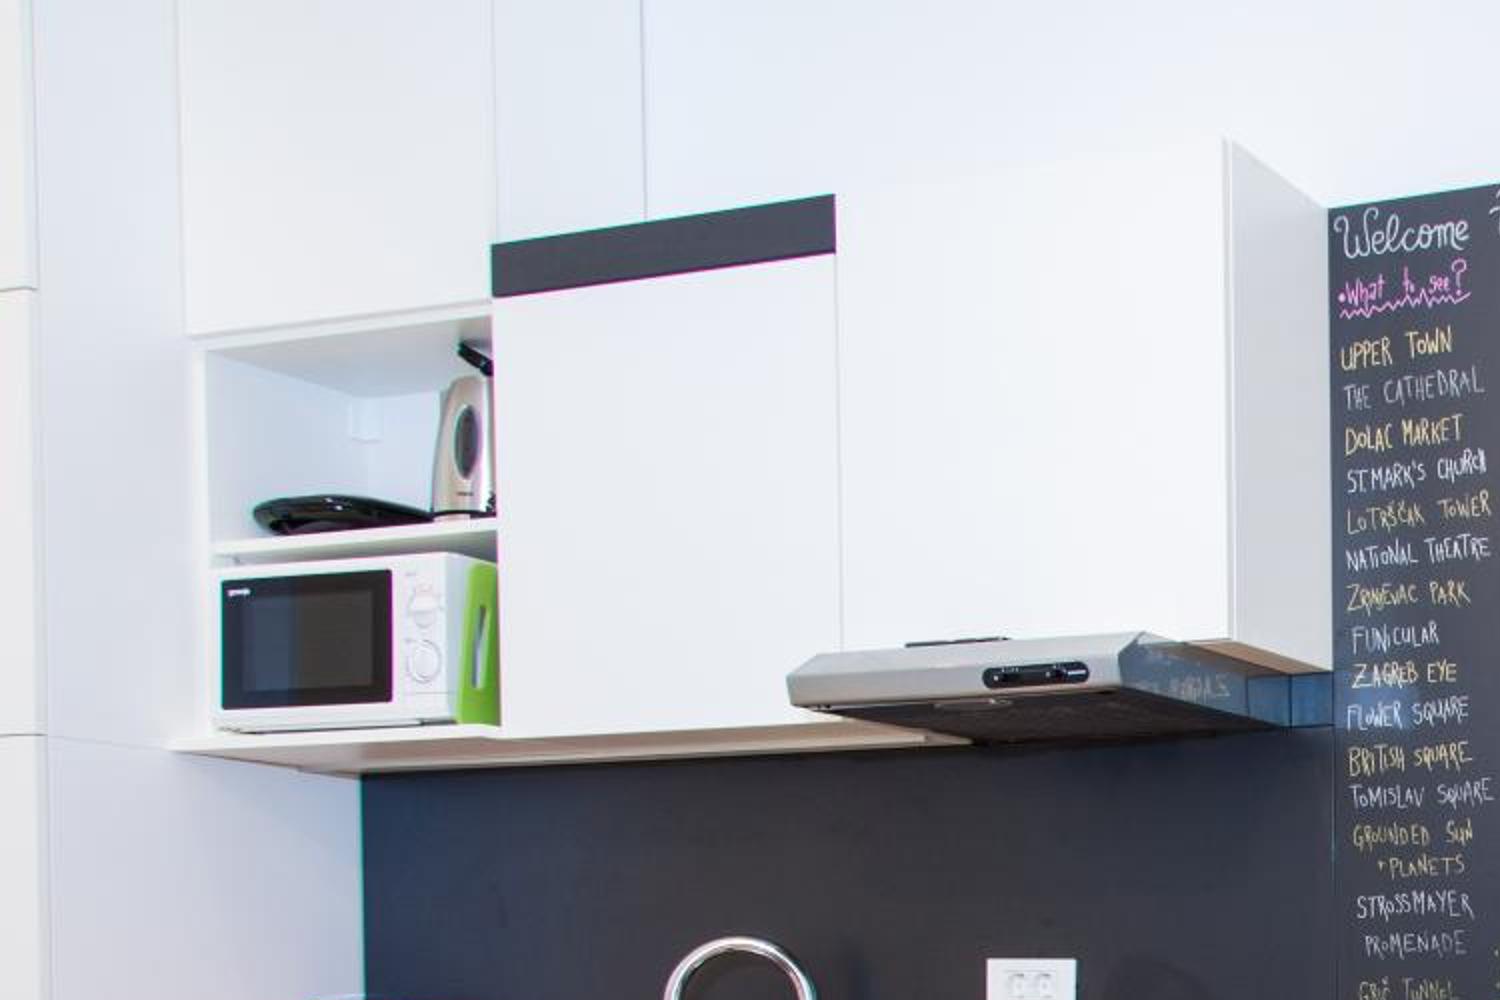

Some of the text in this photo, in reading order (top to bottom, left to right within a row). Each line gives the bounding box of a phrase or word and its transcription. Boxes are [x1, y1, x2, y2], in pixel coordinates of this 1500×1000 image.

[1333, 206, 1471, 259] Welcome
[1344, 273, 1386, 304] What
[1340, 325, 1454, 372] UPPER TOWN
[1343, 364, 1486, 412] THE CATHEDRAL
[1344, 413, 1465, 457] DOLAC MARKET
[1436, 448, 1488, 484] CHURCH
[1437, 488, 1493, 522] TOWER
[1346, 532, 1493, 573] NATIONAL THEATRE
[1428, 579, 1472, 608] PARK
[1351, 619, 1440, 654] FUNICULAR
[1352, 661, 1458, 690] ZAGREB EYE
[1346, 695, 1470, 731] FLOWER SQUARE
[1349, 740, 1473, 778] BRITISH SQUARE
[1349, 776, 1495, 810] TOMISLAV SQUARE
[1352, 822, 1431, 858] GROUNDED
[1356, 888, 1476, 923] STROSSMAYER
[1364, 928, 1468, 962] PROMENADE
